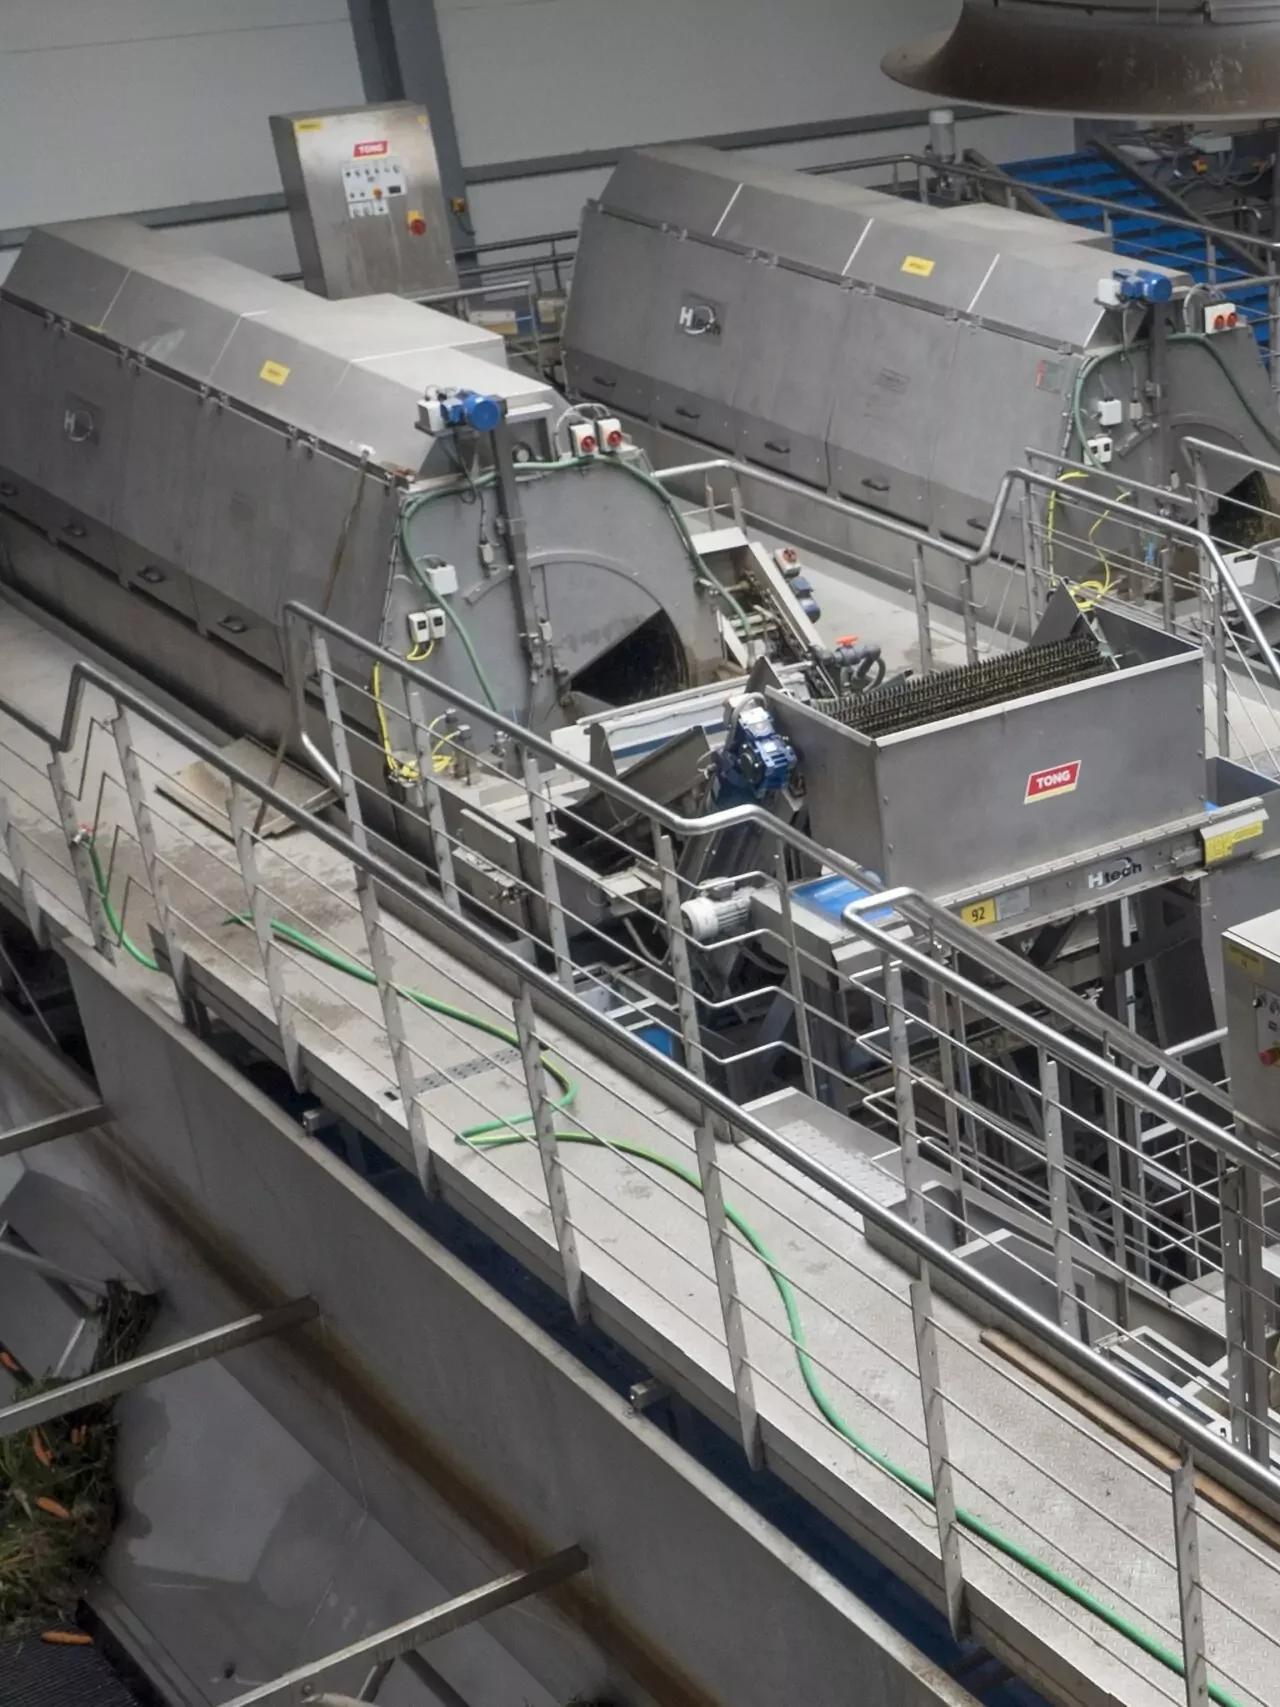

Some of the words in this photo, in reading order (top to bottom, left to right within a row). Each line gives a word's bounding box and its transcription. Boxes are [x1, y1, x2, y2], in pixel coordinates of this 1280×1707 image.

[1036, 770, 1071, 789] TONG
[1088, 860, 1142, 889] Htech
[971, 906, 986, 922] 92
